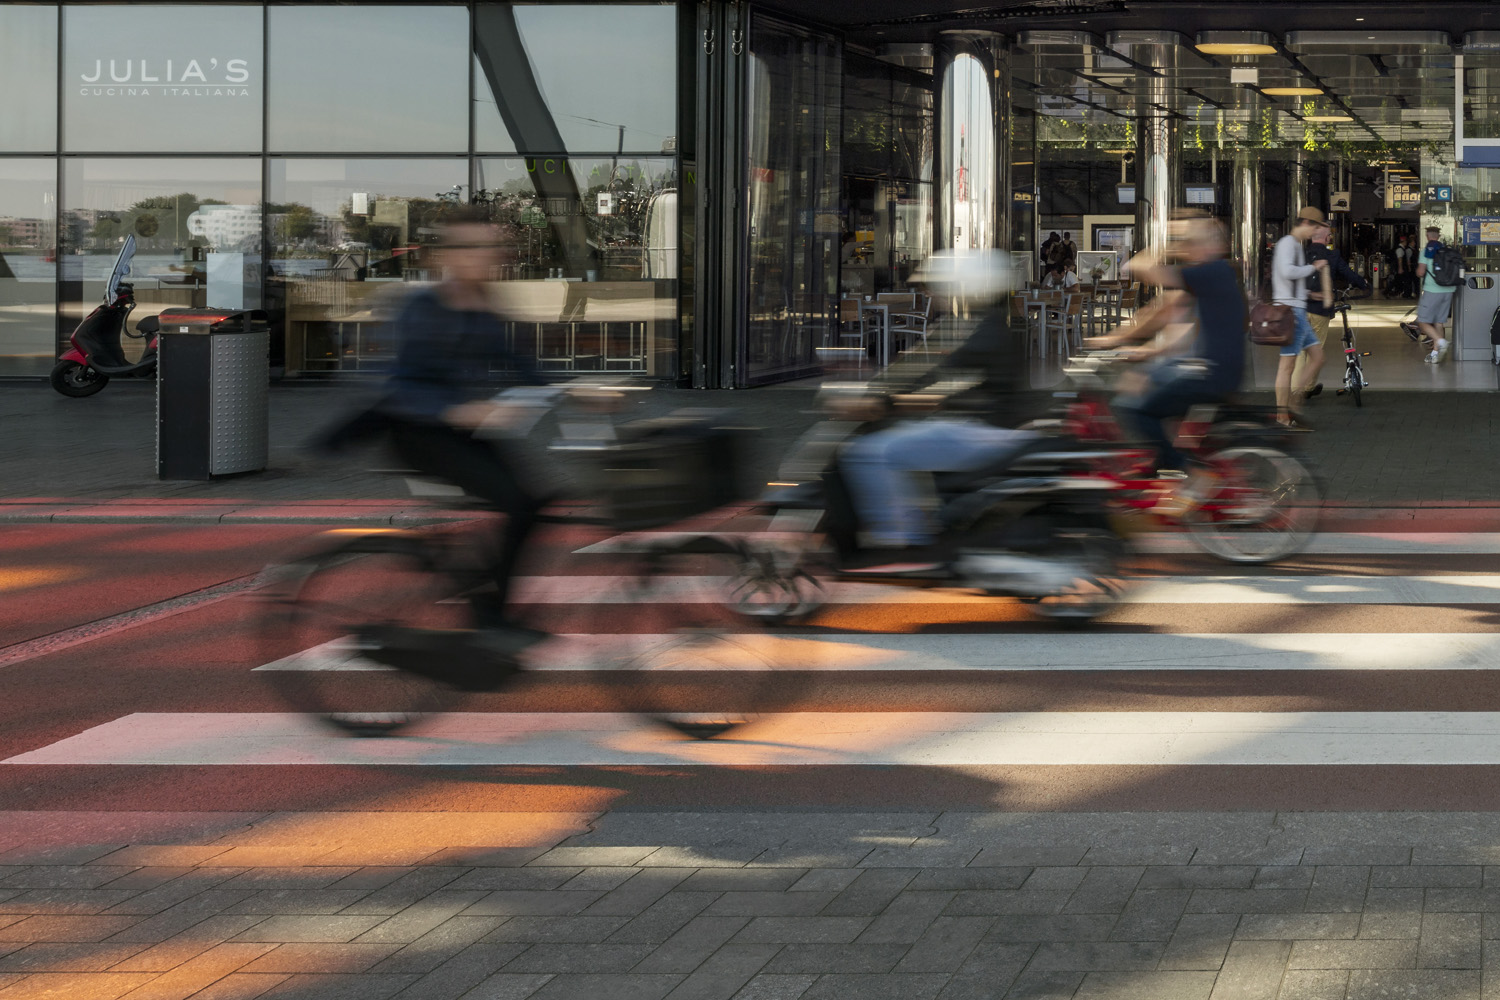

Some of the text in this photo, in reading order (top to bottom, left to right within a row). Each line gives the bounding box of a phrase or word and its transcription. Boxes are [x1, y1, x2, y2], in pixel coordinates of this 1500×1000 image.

[80, 57, 249, 82] JULIA'S
[80, 88, 249, 96] CUCINA ITALIANA
[504, 158, 600, 176] CUCINA
[1439, 189, 1448, 198] G
